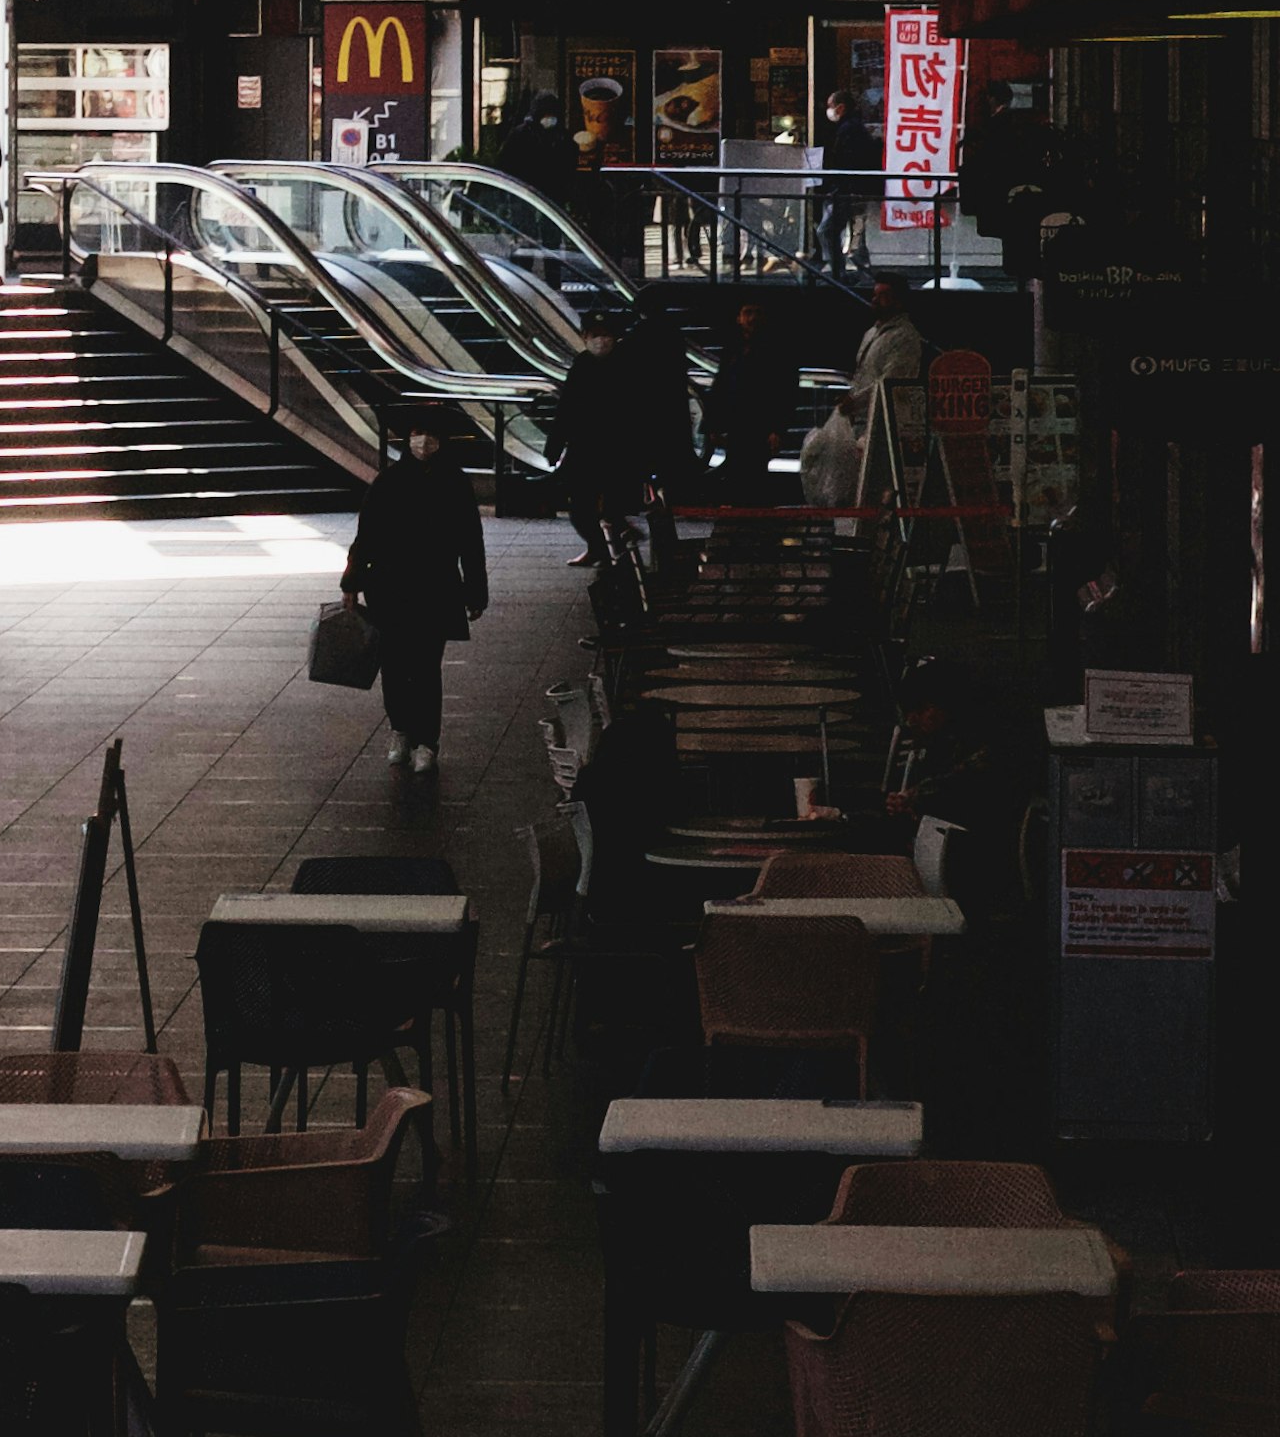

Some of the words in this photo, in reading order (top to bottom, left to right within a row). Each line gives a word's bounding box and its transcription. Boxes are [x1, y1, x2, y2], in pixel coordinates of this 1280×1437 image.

[375, 134, 396, 150] B1
[1160, 357, 1211, 373] MUFG
[930, 377, 990, 393] BURGER
[930, 394, 990, 419] KING
